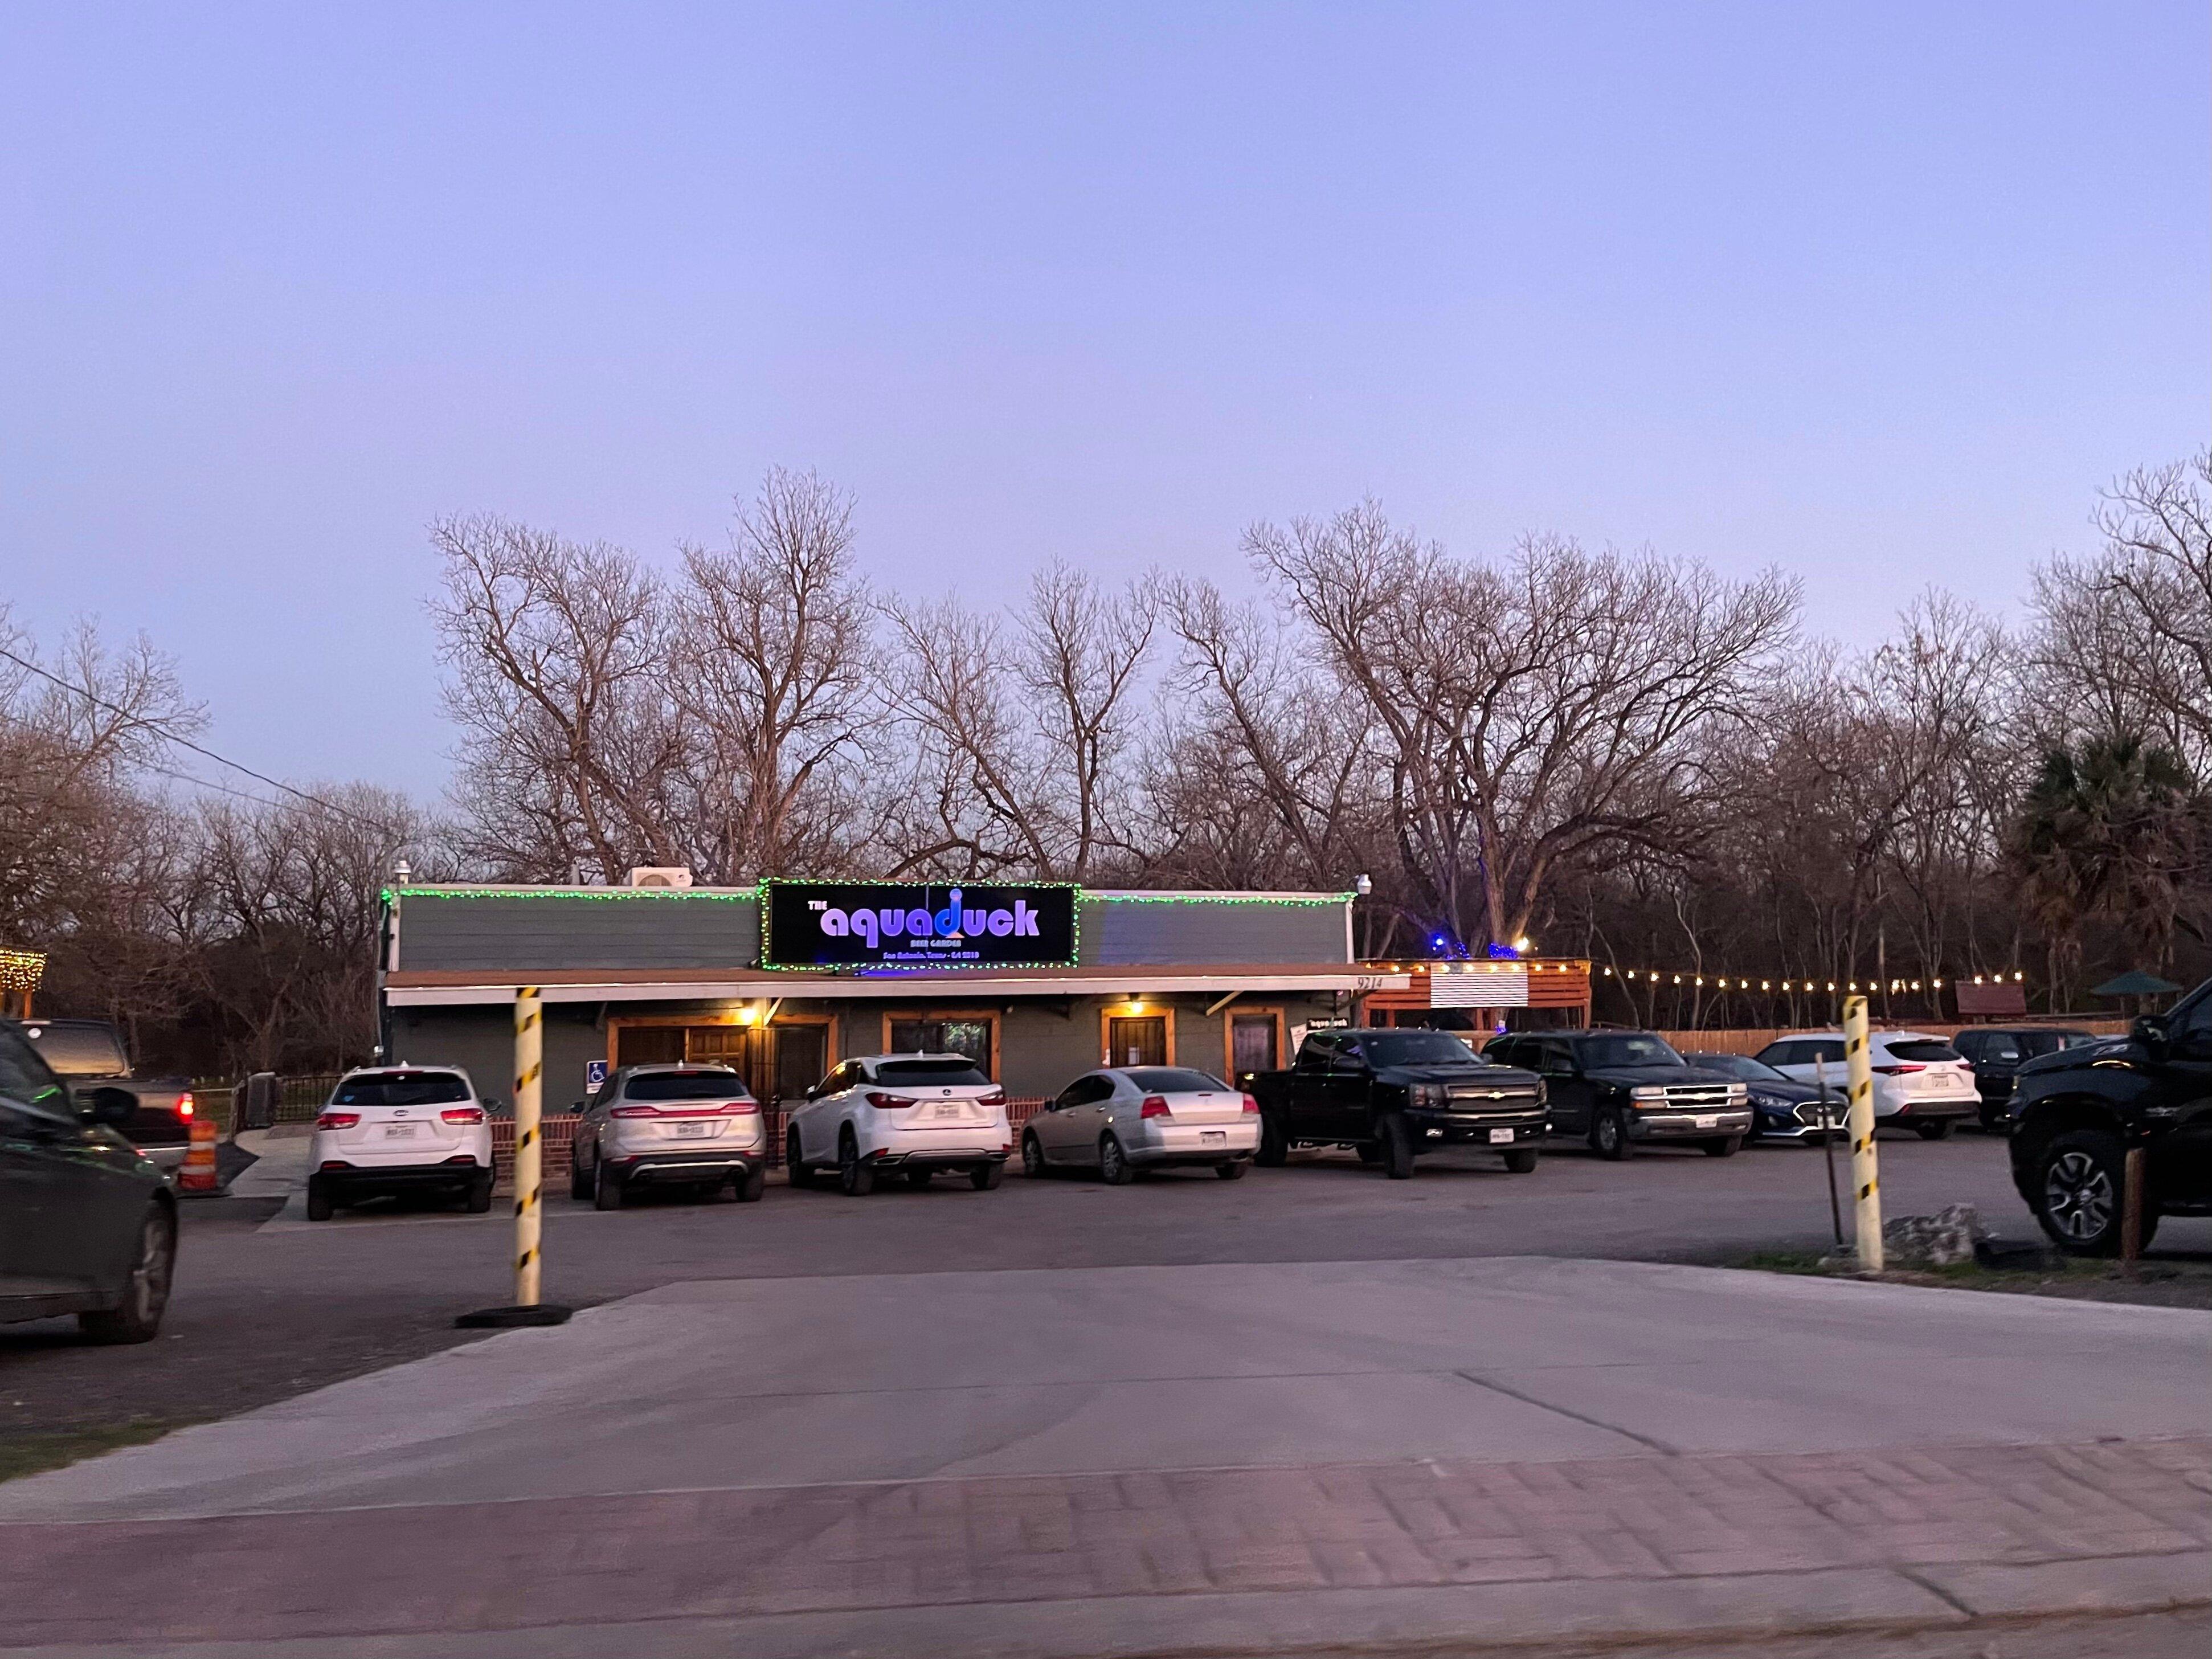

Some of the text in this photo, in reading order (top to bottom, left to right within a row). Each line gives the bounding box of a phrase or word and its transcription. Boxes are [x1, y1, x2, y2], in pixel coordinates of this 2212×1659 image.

[808, 901, 827, 910] THE
[820, 888, 1040, 949] aquaduck
[1358, 976, 1383, 989] 9214
